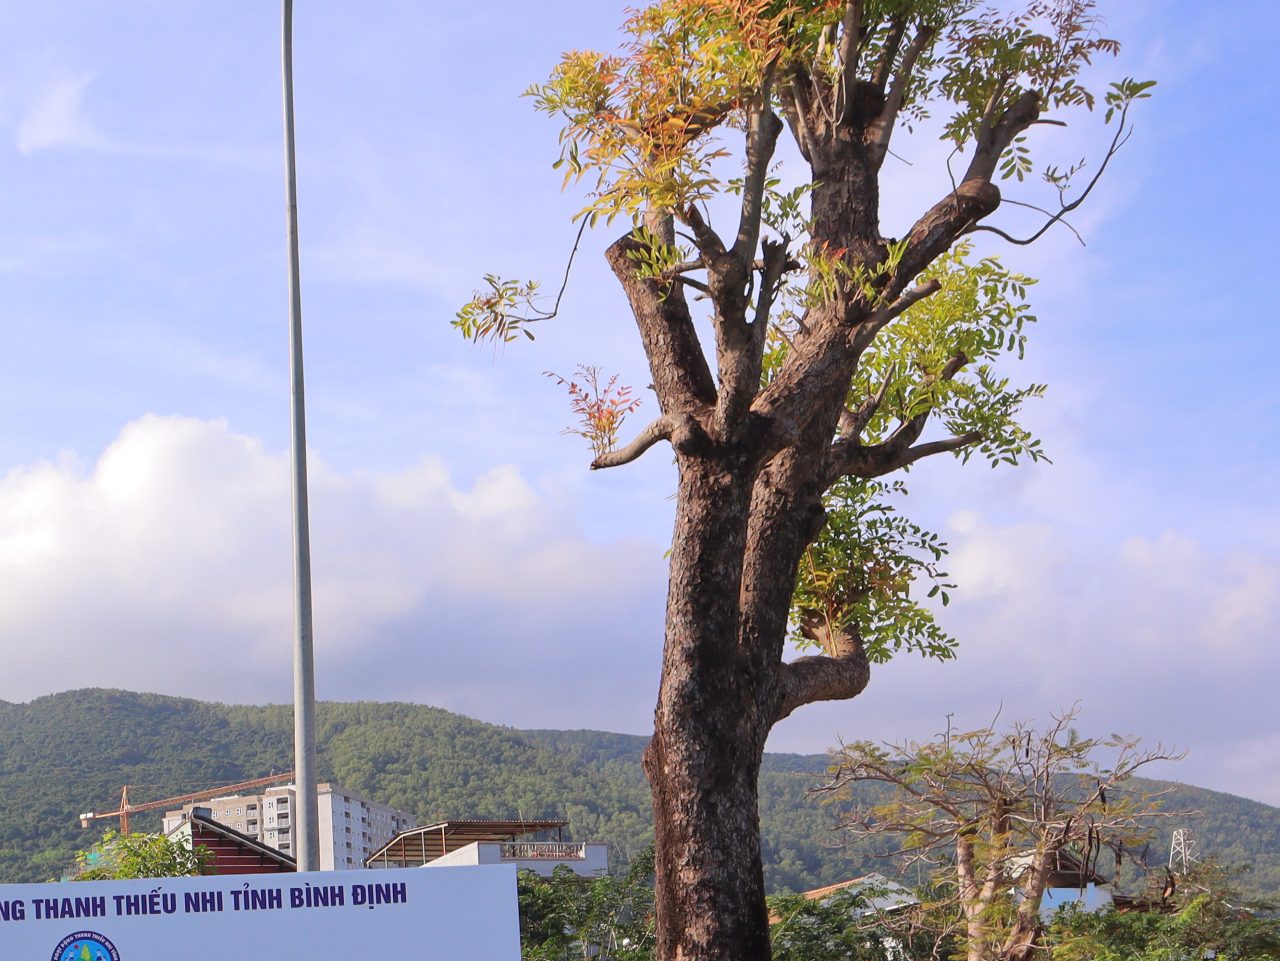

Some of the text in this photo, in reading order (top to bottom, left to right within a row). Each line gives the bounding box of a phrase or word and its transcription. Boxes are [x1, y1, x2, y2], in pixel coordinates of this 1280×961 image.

[32, 895, 106, 919] THANH
[113, 887, 177, 916] THIẾU
[184, 891, 223, 913] NHI
[230, 883, 283, 911] TỈNH
[290, 883, 344, 909] BÌNH
[352, 882, 407, 909] ĐỊNH
